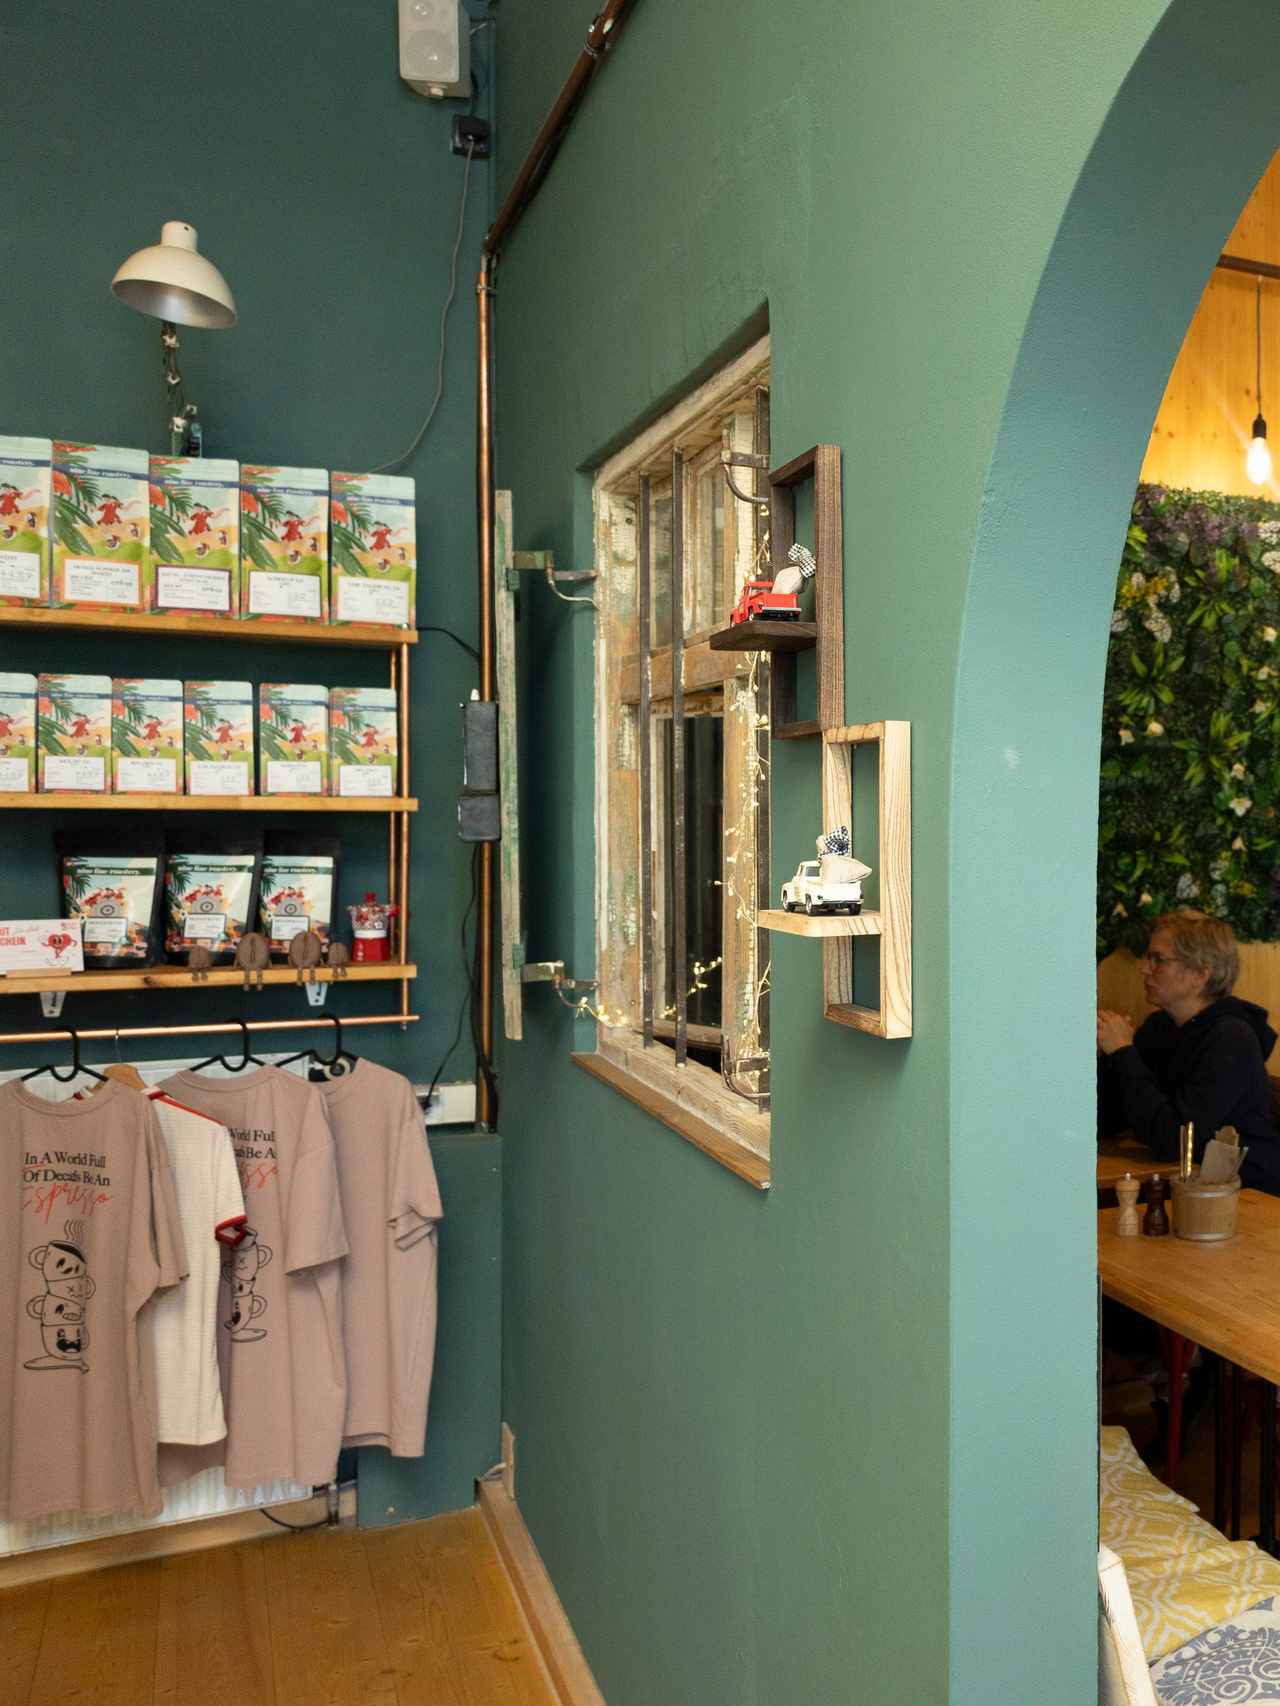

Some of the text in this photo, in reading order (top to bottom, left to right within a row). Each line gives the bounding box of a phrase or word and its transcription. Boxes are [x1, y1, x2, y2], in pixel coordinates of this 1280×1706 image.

[178, 864, 193, 872] nine
[246, 1146, 262, 1158] Be
[25, 1151, 106, 1168] In A World Full
[23, 1169, 111, 1186] Of Decafs Be An
